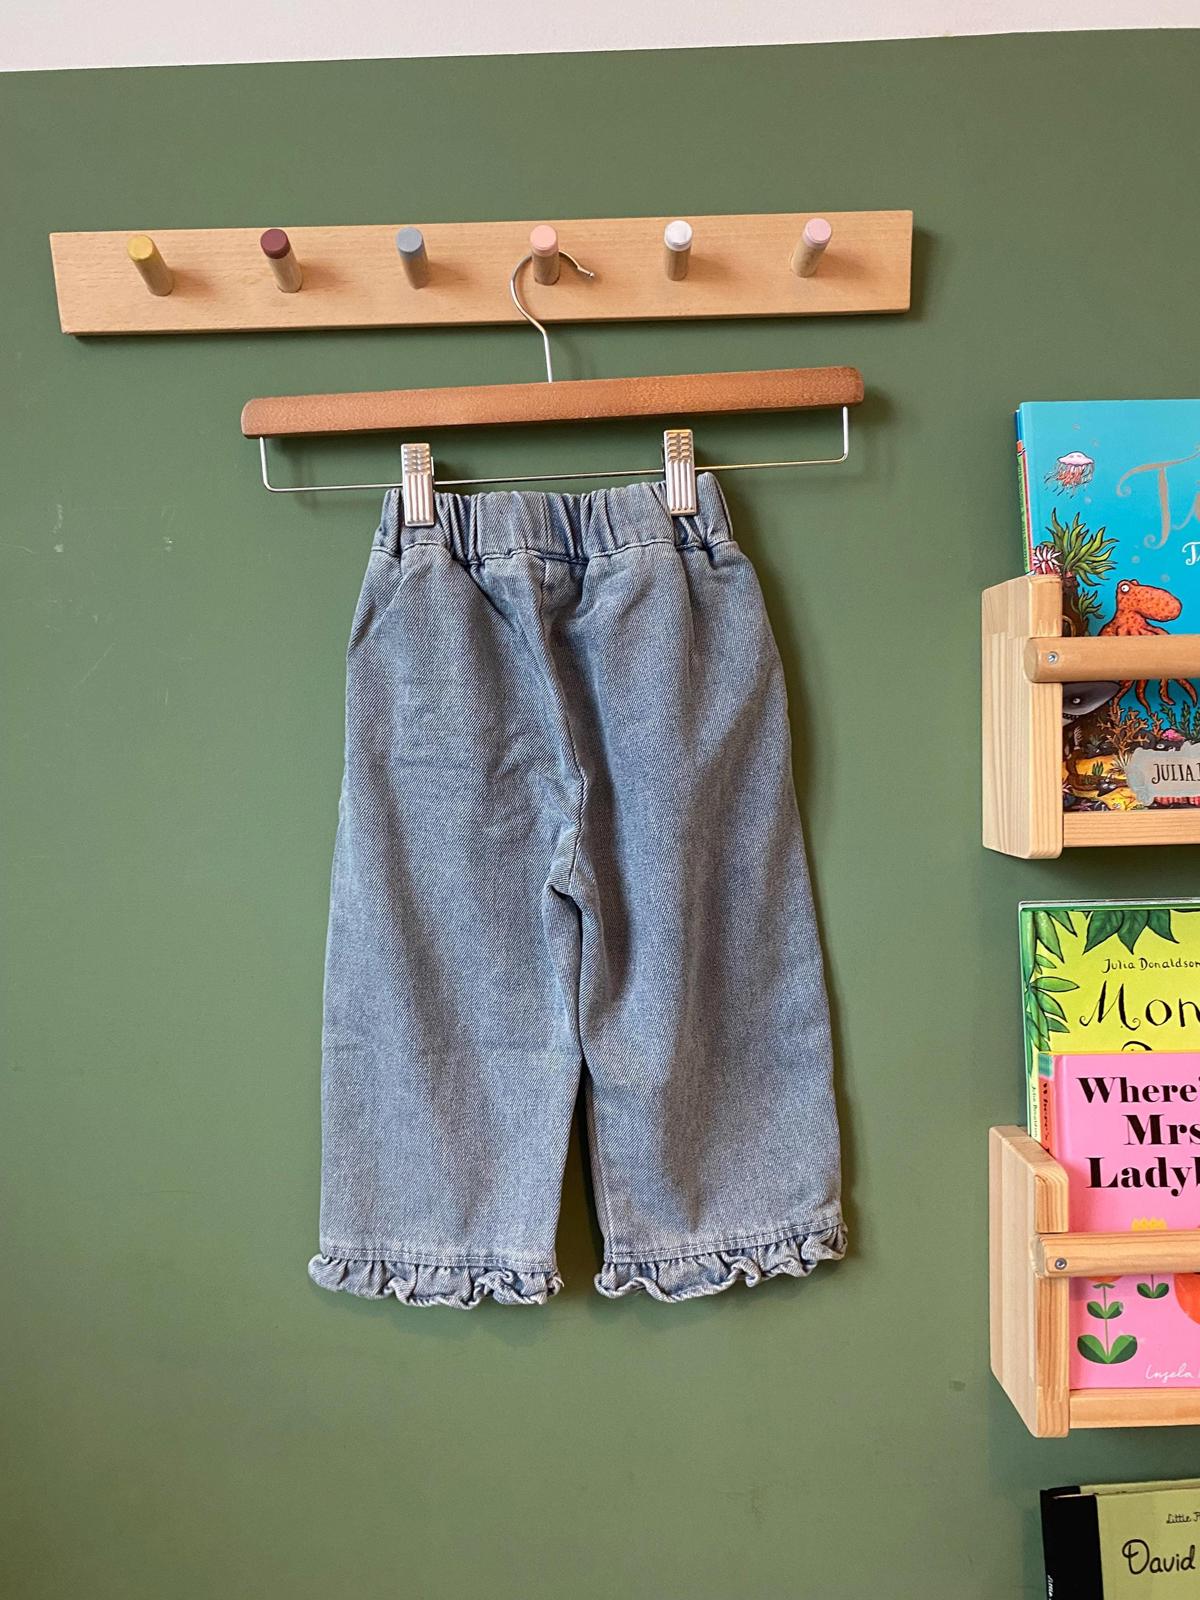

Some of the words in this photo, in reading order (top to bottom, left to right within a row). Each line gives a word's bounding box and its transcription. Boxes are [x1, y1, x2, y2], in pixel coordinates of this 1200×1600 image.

[1115, 444, 1200, 550] T
[1151, 763, 1196, 785] JULIA
[1101, 958, 1136, 974] Julia
[1121, 1538, 1196, 1575] David
